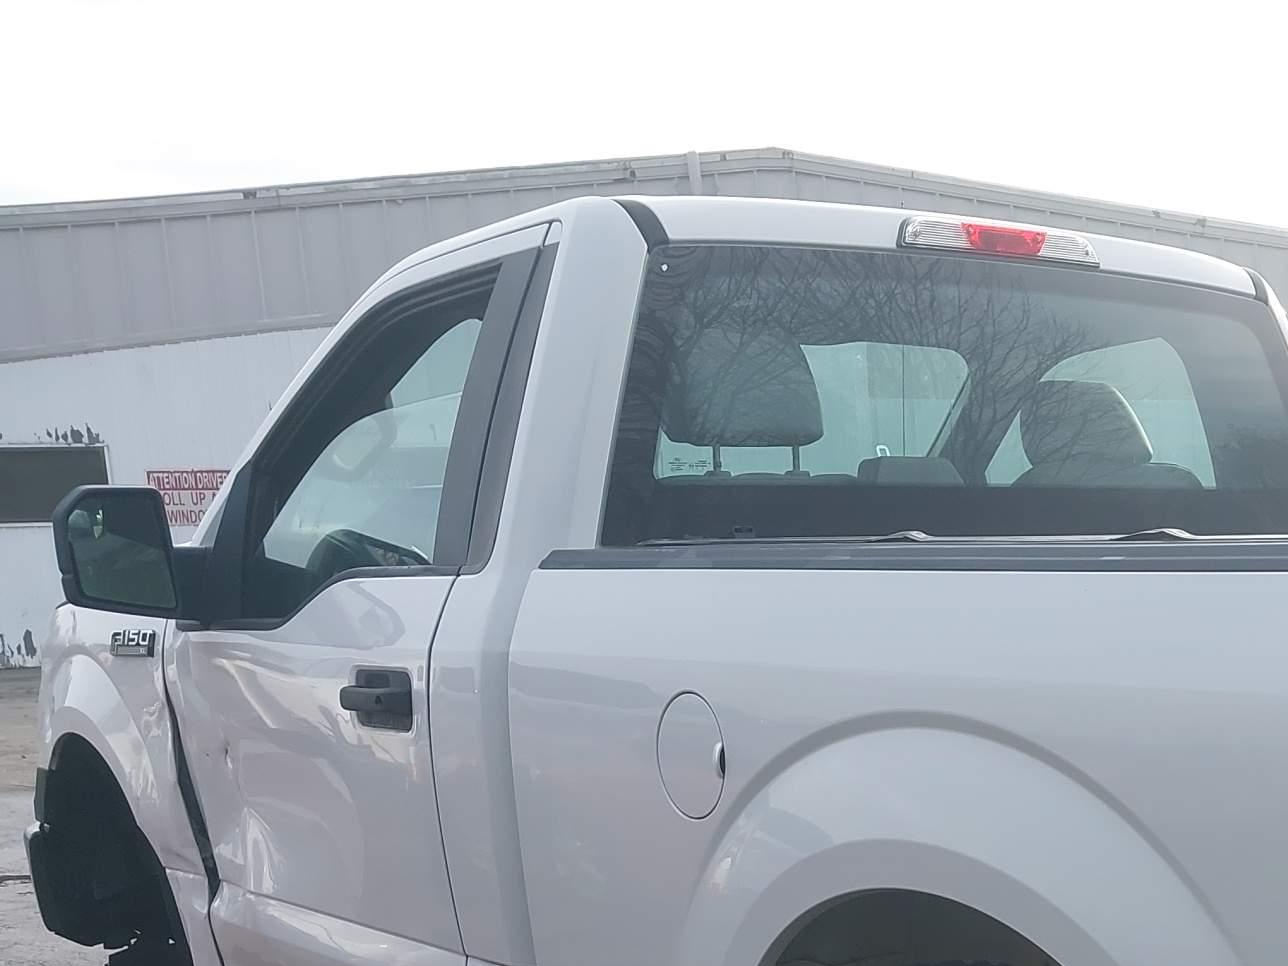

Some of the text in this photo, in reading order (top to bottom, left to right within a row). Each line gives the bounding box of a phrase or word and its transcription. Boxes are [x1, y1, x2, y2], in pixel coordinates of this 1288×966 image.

[149, 472, 197, 489] ATTENTION
[162, 491, 186, 506] OLL
[190, 491, 206, 506] UP
